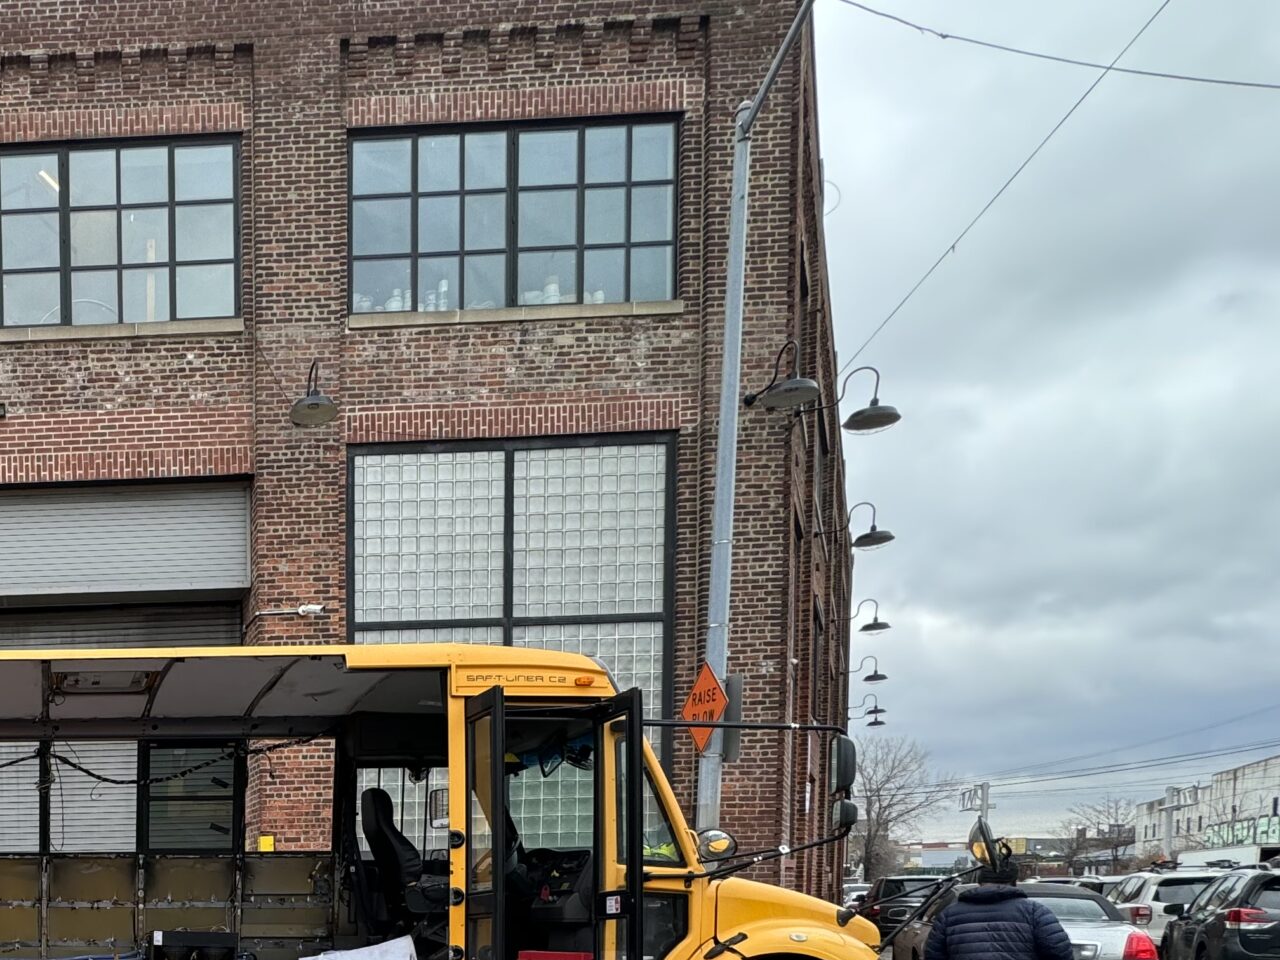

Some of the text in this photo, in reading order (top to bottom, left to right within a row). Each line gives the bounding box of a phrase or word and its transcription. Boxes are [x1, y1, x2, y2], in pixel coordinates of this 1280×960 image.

[466, 674, 567, 684] SAF-T-LINER C2
[691, 687, 718, 708] RAISE
